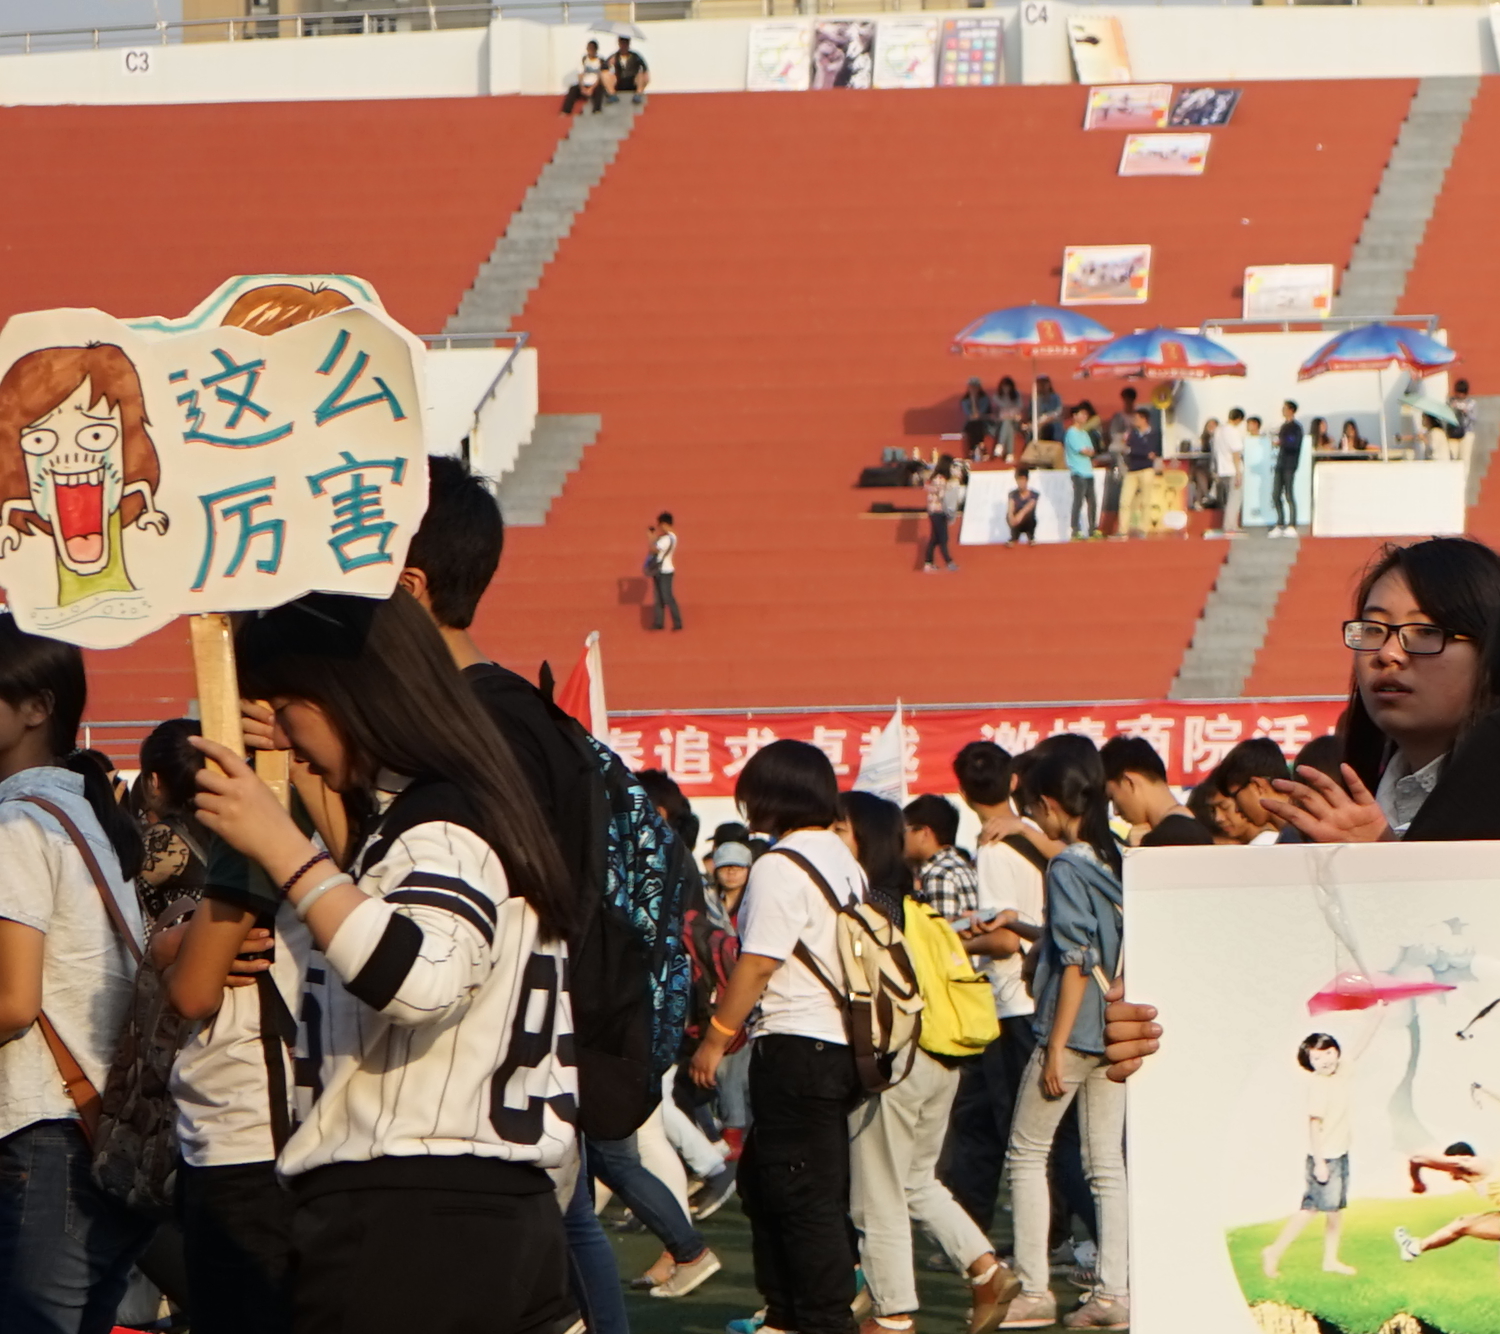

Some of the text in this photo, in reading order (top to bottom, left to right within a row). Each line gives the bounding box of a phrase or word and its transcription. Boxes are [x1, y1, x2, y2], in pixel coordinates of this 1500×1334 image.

[126, 51, 149, 72] C3
[168, 329, 407, 449] 这么
[190, 451, 407, 593] 厉害
